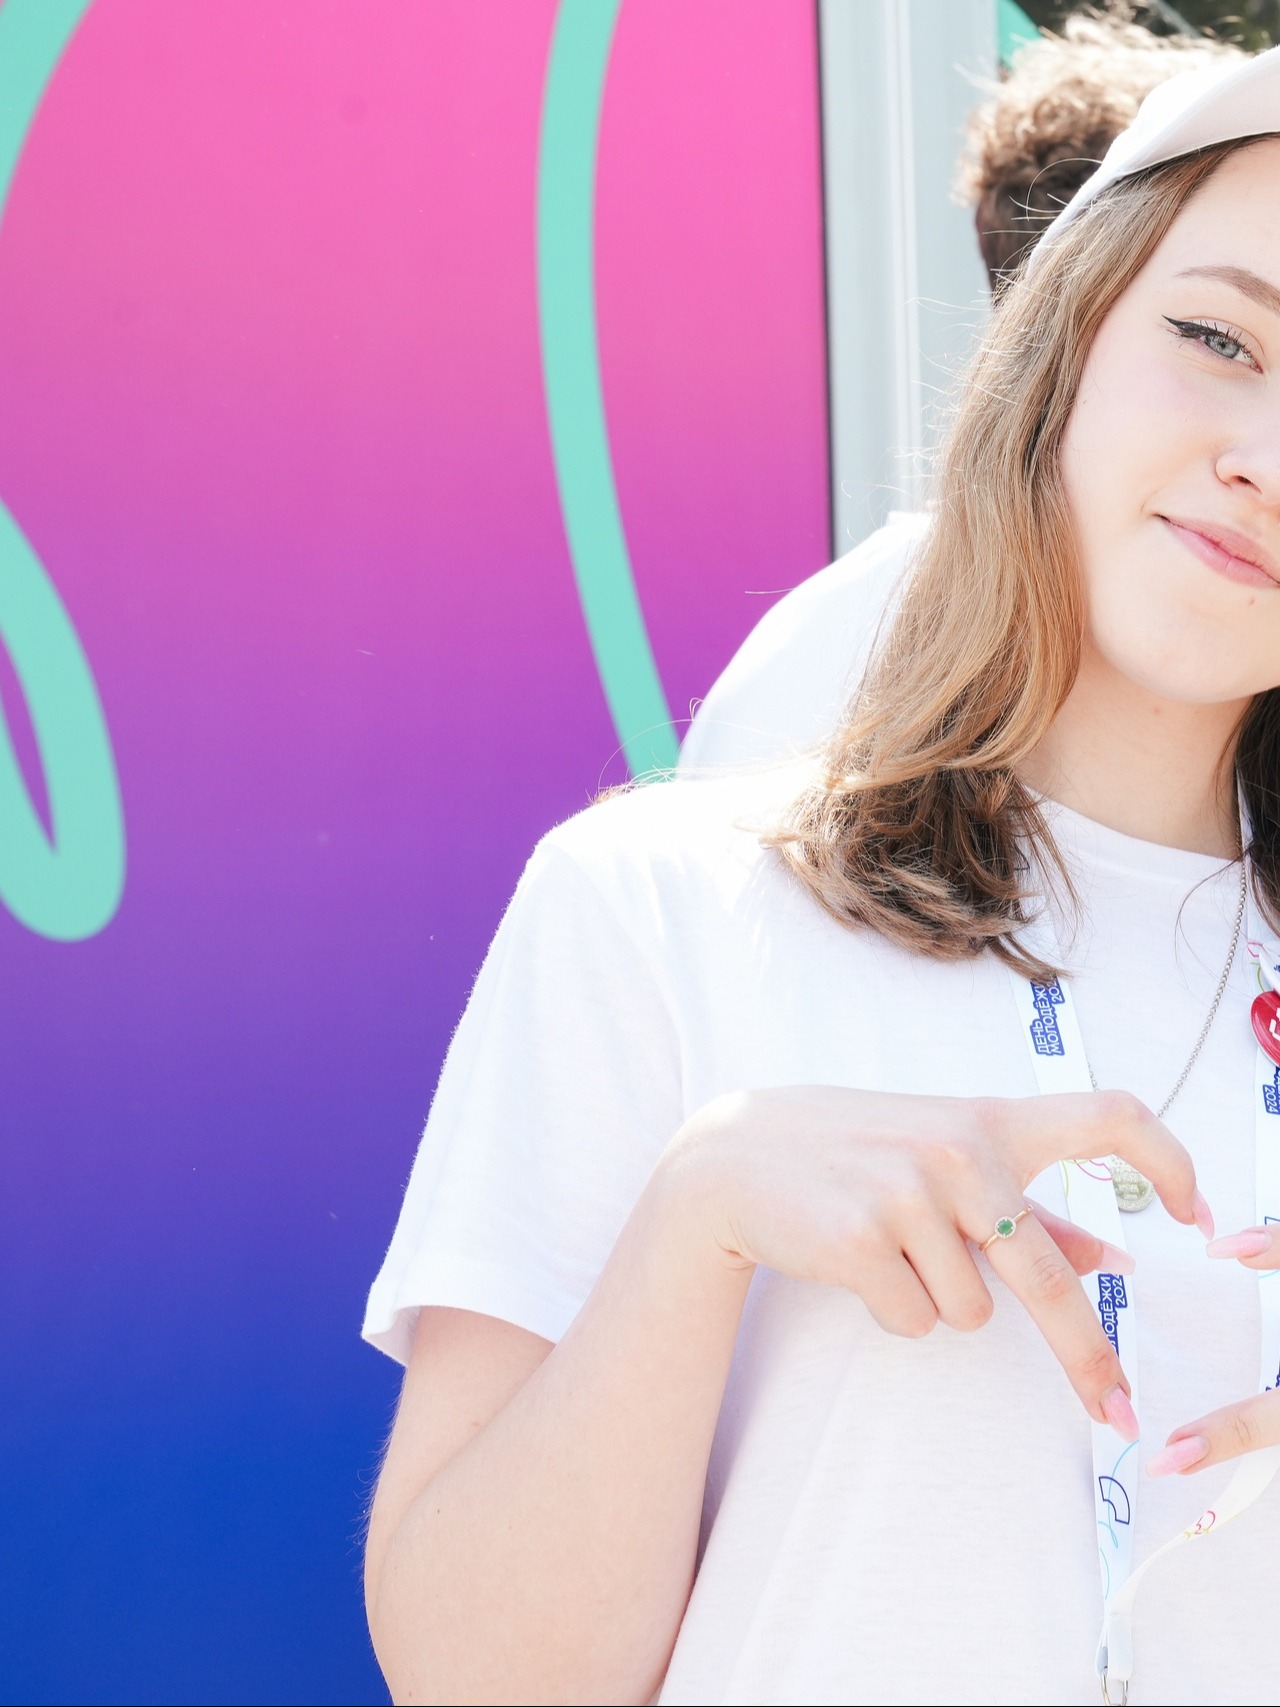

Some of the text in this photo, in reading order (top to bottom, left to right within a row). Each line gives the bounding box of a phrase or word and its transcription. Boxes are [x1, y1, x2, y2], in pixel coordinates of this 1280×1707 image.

[1047, 979, 1063, 1003] 202
[1034, 984, 1062, 1054] МОЛОДЁЖ
[1032, 1020, 1052, 1054] ДЕНЬ
[1264, 1086, 1279, 1112] 2024
